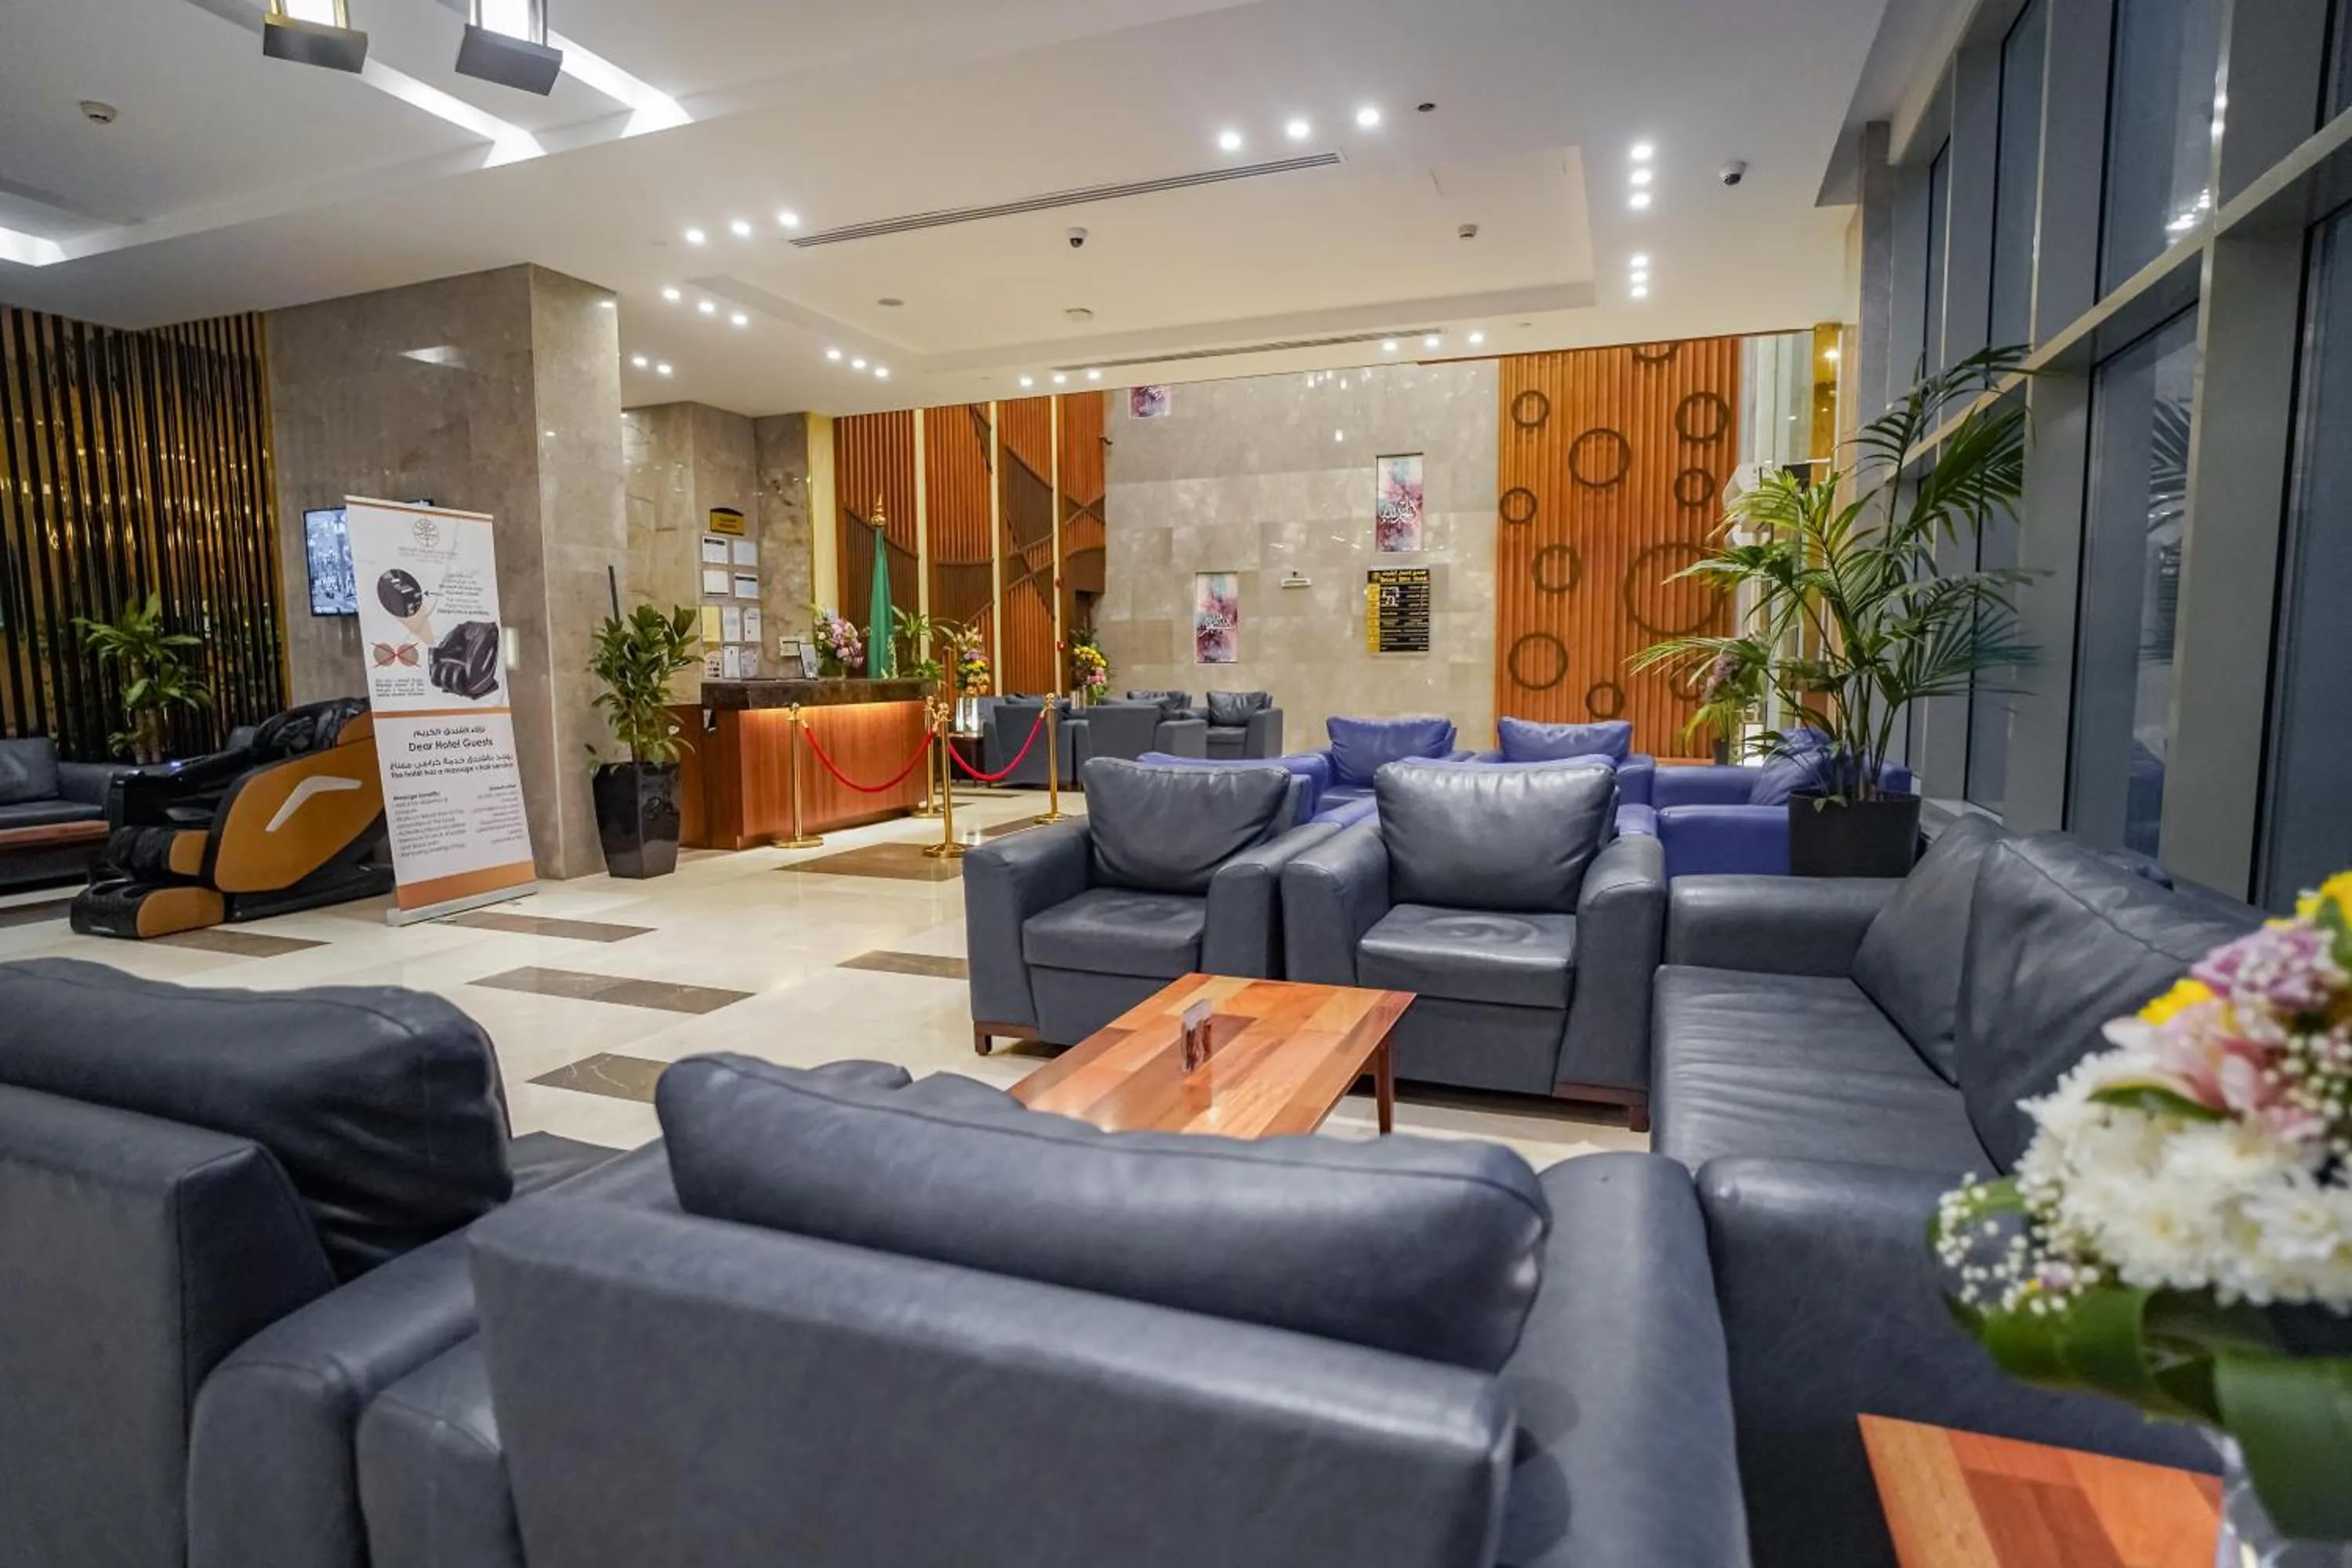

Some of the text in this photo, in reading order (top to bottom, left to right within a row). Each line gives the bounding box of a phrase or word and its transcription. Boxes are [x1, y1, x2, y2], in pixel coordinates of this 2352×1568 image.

[408, 737, 493, 753] Dear Hotel Guests
[444, 766, 474, 775] massage
